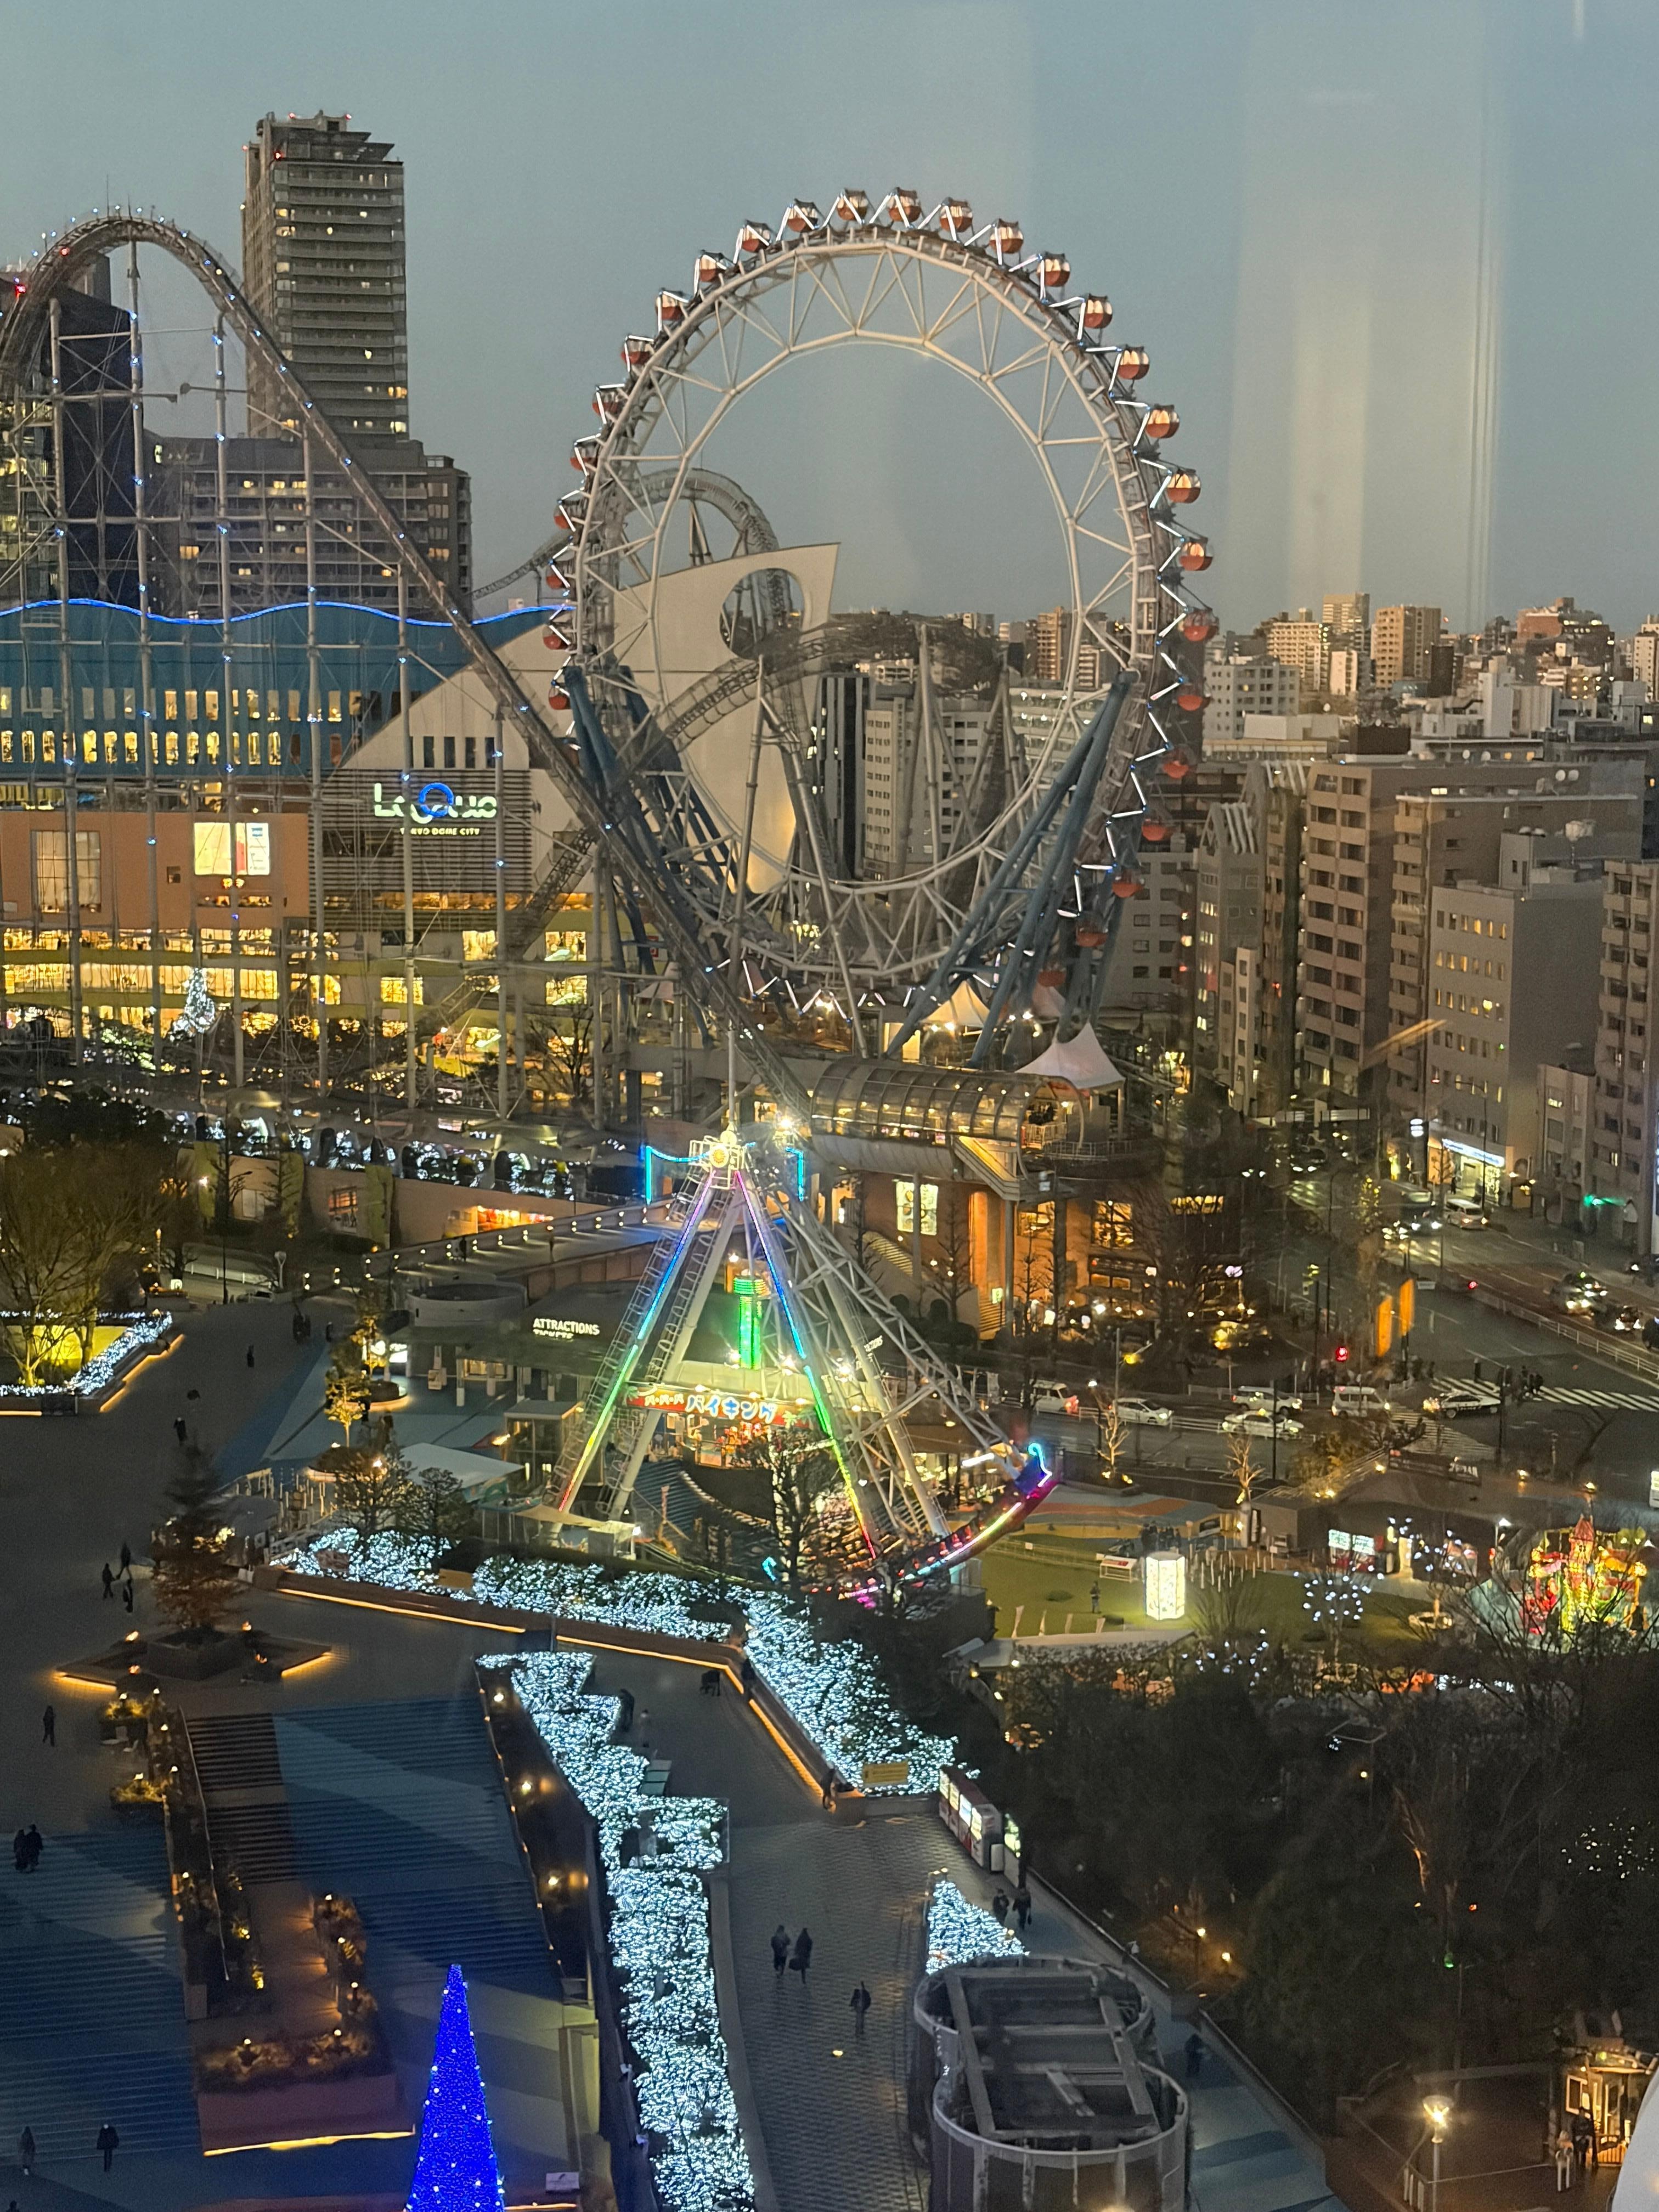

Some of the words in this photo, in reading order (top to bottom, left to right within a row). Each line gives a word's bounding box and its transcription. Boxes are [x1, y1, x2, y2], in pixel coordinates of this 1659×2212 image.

[374, 782, 497, 824] LaQua
[400, 827, 430, 836] TKYO
[431, 827, 458, 836] DOME
[459, 827, 480, 836] CITY
[533, 1318, 600, 1335] ATTRACTIONS
